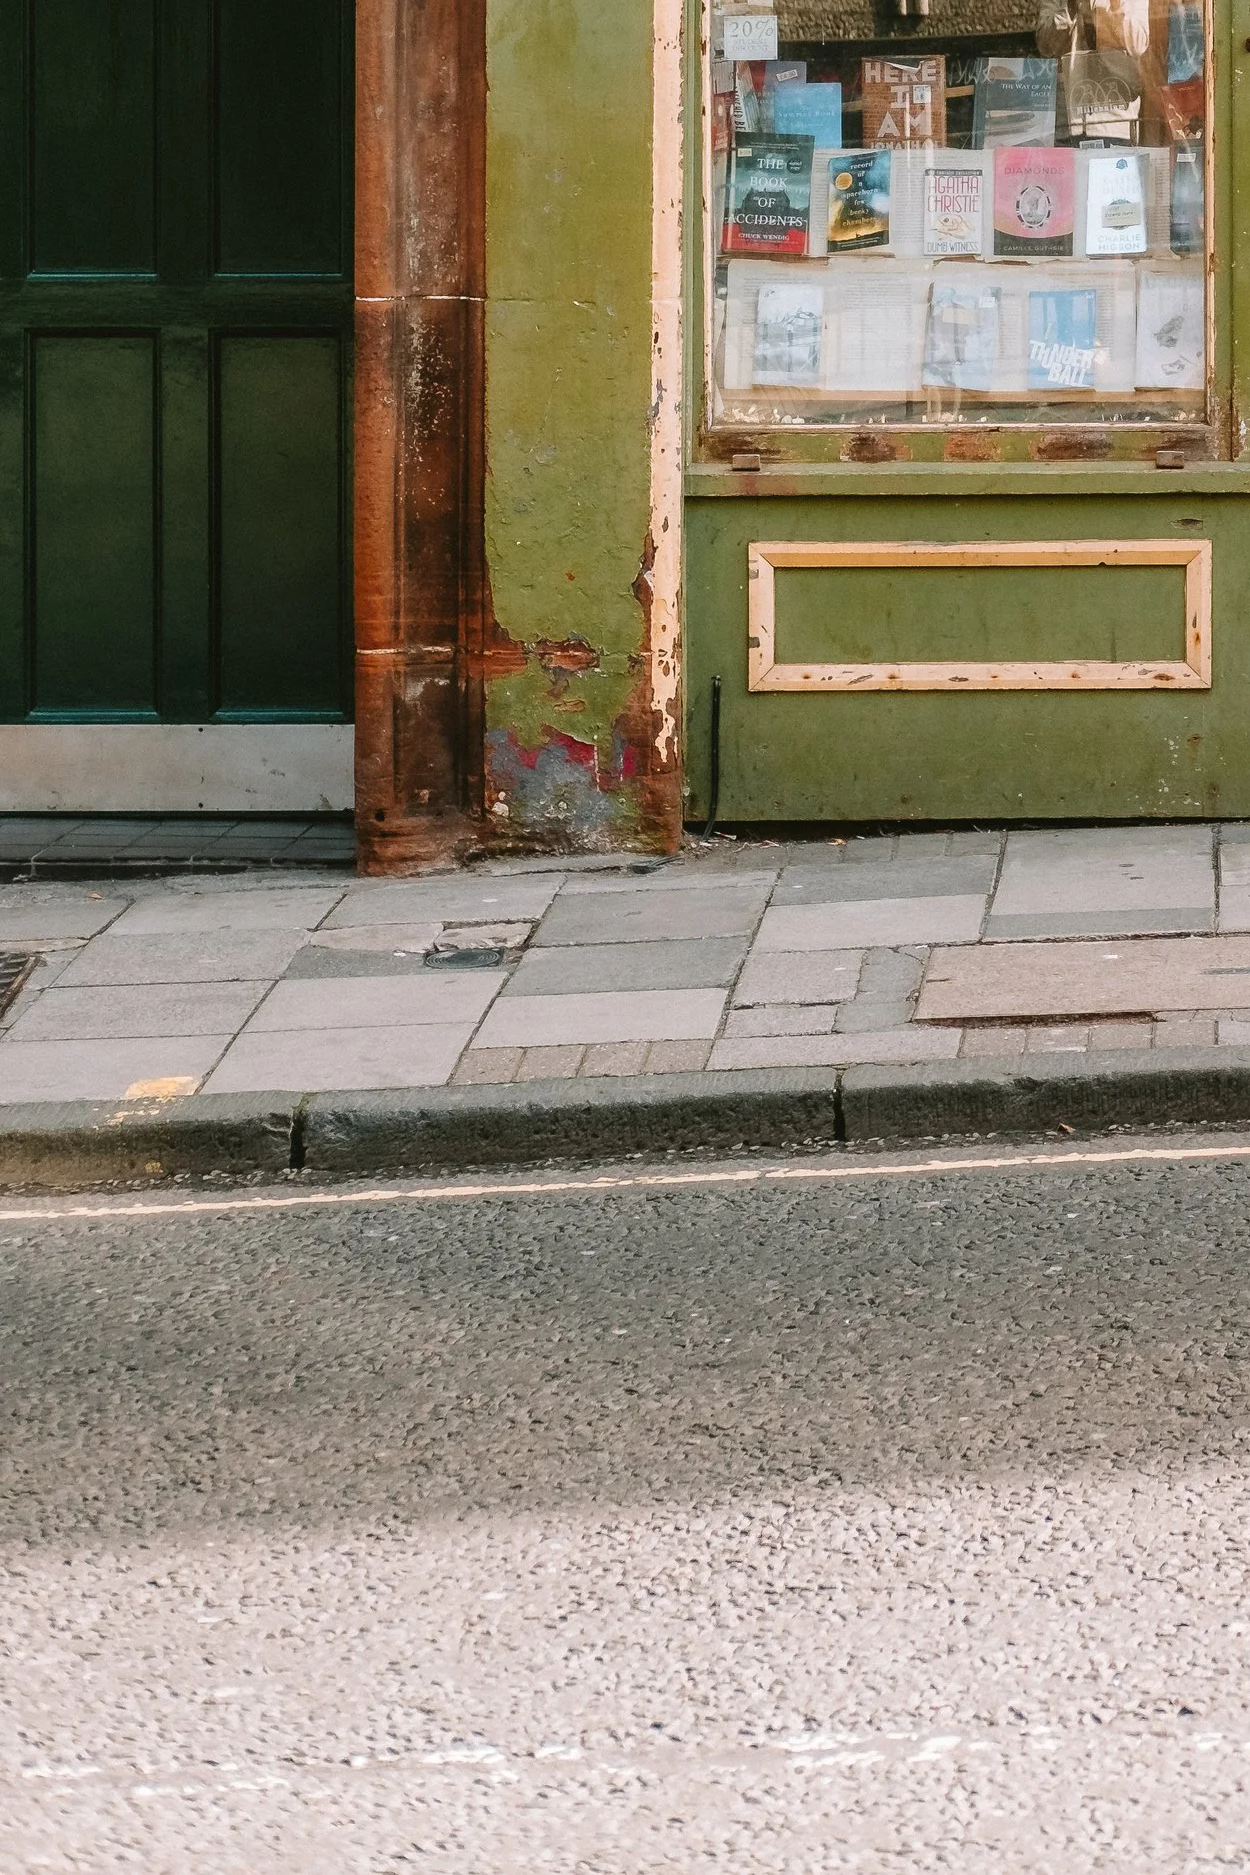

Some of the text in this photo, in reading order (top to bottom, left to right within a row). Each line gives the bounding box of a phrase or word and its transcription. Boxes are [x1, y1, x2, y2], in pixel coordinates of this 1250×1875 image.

[729, 20, 774, 38] 20%
[890, 86, 910, 109] I
[877, 109, 932, 137] AM
[757, 158, 784, 170] THE
[850, 160, 873, 170] record
[1004, 166, 1065, 175] DIAMONDS
[750, 177, 788, 187] BOOK
[929, 176, 979, 194] AGATHA
[758, 197, 776, 208] OF
[927, 195, 980, 213] CHRISTIE
[729, 214, 803, 227] ACCIDENTS
[763, 233, 790, 241] WENDIG
[1098, 233, 1142, 244] CHARLIE
[927, 242, 978, 252] DUMB WITNESS
[1098, 243, 1141, 252] HIGSON
[1029, 339, 1097, 371] THUNDER
[1047, 361, 1091, 387] BALL
